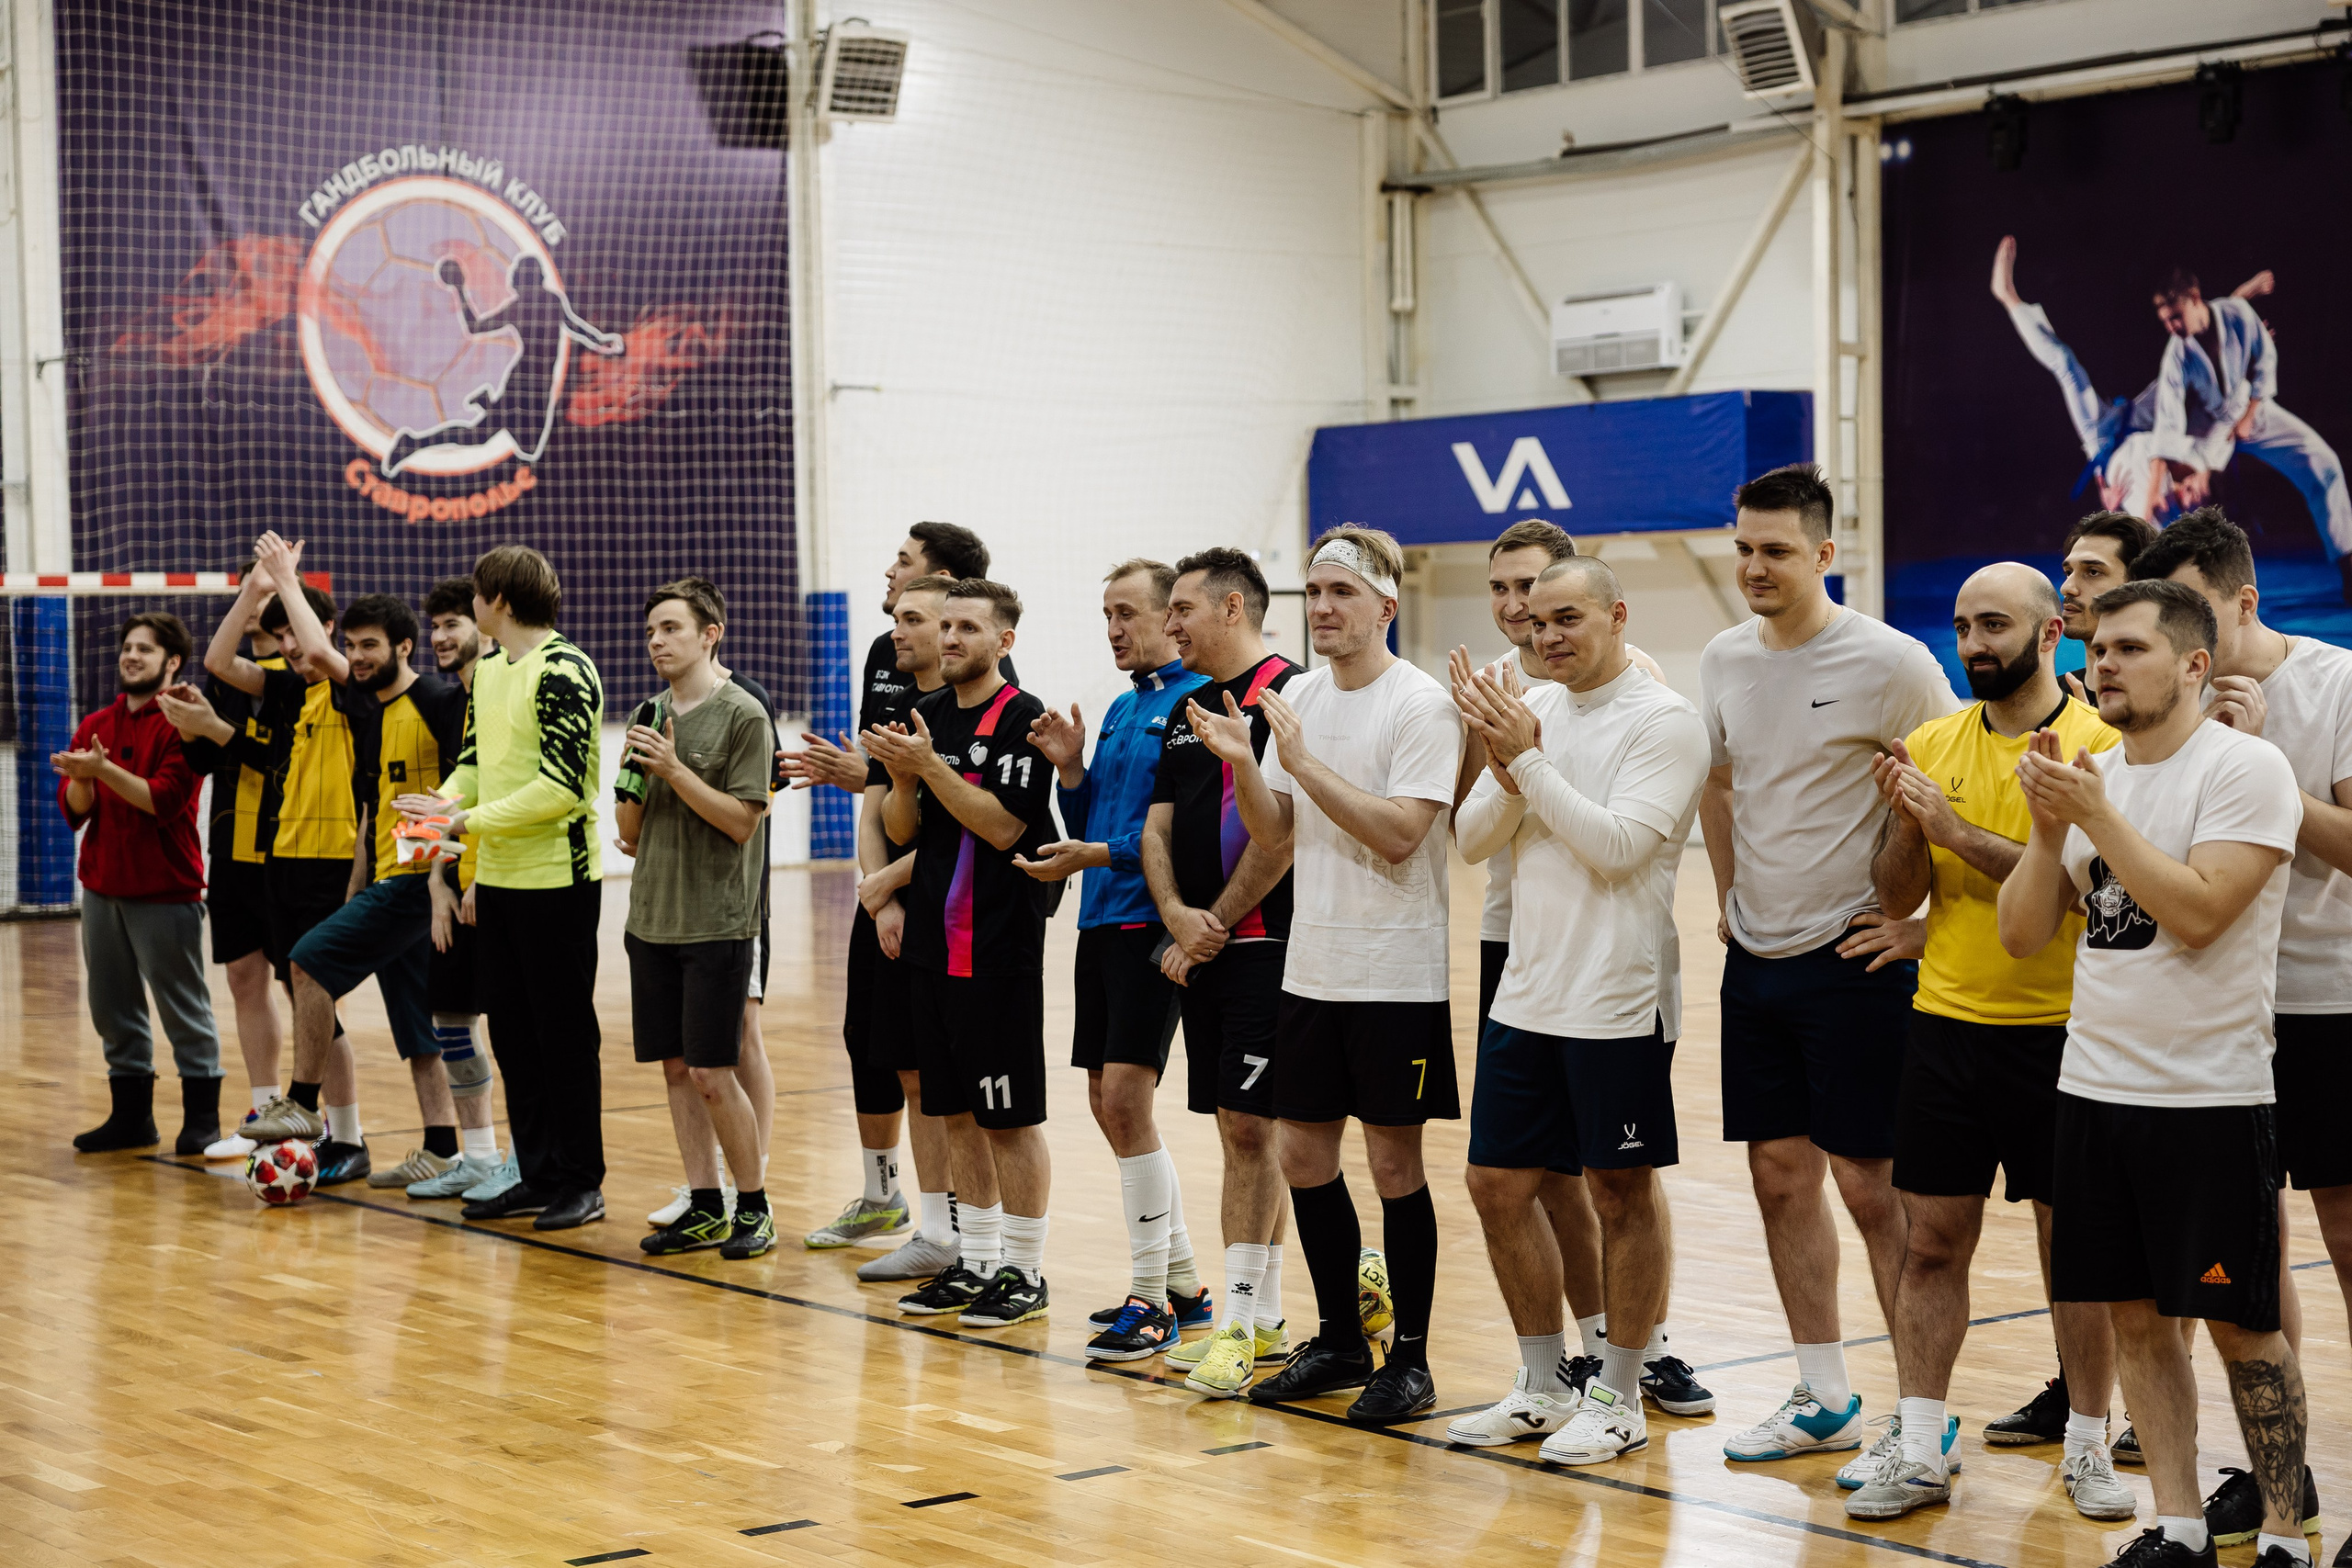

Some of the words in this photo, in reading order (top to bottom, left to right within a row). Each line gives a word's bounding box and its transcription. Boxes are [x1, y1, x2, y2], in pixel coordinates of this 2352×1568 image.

[298, 144, 504, 227] ГАНДБОЛЬНЫЙ
[503, 177, 568, 246] КЛУБ
[345, 458, 537, 524] Ставрополье
[997, 753, 1033, 789] 11
[1945, 794, 1967, 804] ÖGEL
[1240, 1054, 1269, 1091] 7
[1411, 1058, 1427, 1100] 7
[978, 1074, 1012, 1110] 11
[1362, 1267, 1386, 1289] ECT
[2199, 1276, 2232, 1284] adidas
